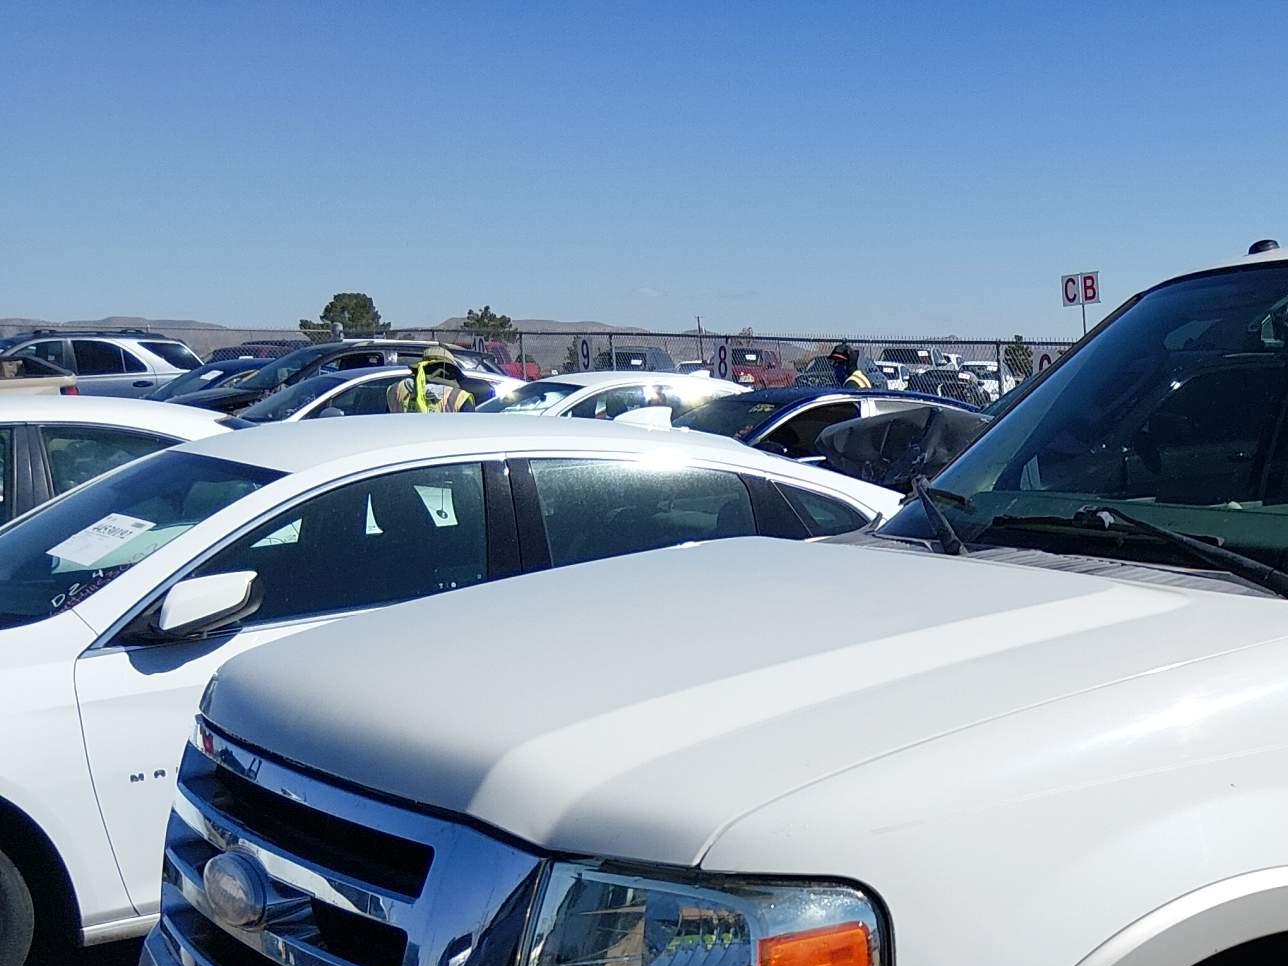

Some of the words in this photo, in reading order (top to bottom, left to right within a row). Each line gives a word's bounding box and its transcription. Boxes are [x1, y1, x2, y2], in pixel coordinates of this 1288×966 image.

[1064, 277, 1077, 303] C
[1083, 275, 1096, 301] B
[581, 339, 590, 370] 9
[717, 345, 728, 379] 8
